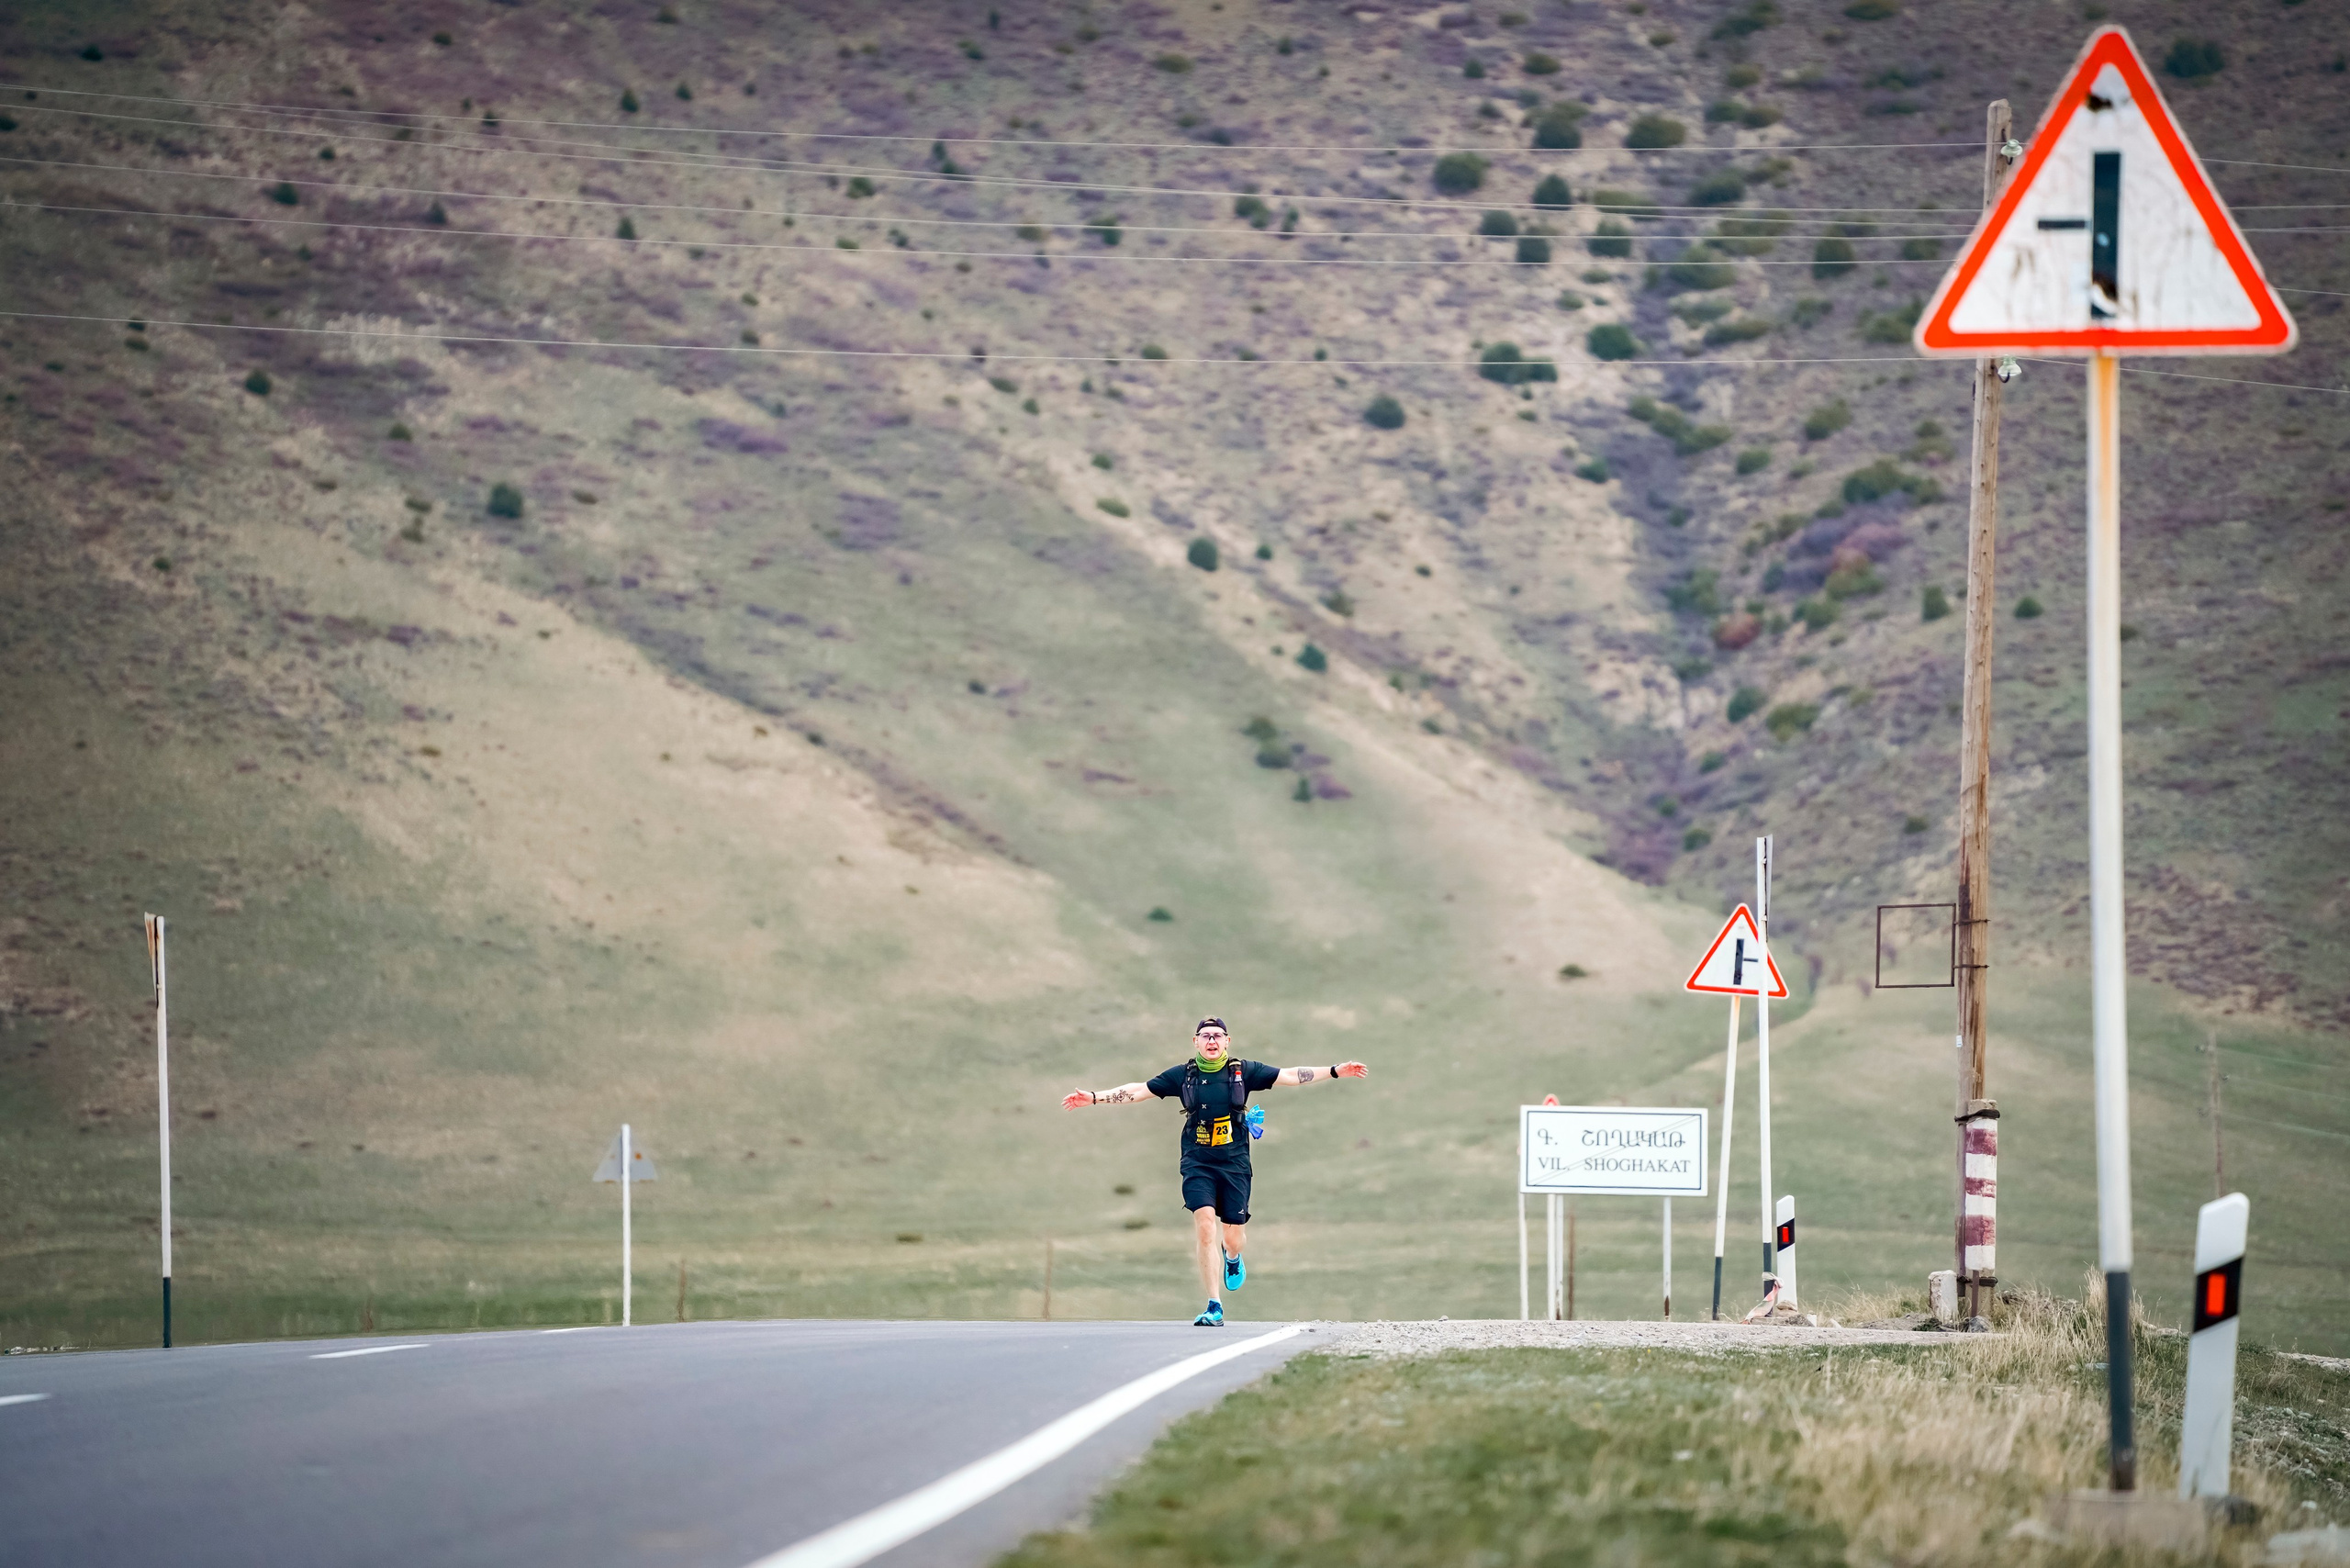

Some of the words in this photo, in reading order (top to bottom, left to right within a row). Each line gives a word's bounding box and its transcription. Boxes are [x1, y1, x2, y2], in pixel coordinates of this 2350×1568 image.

[1215, 1125, 1228, 1136] 23
[1538, 1128, 1558, 1146] Գ.
[1582, 1128, 1685, 1148] ՇՈՂԱԿԱԹ
[1538, 1157, 1571, 1171] VIL.
[1583, 1157, 1691, 1174] SHOGHAKAT
